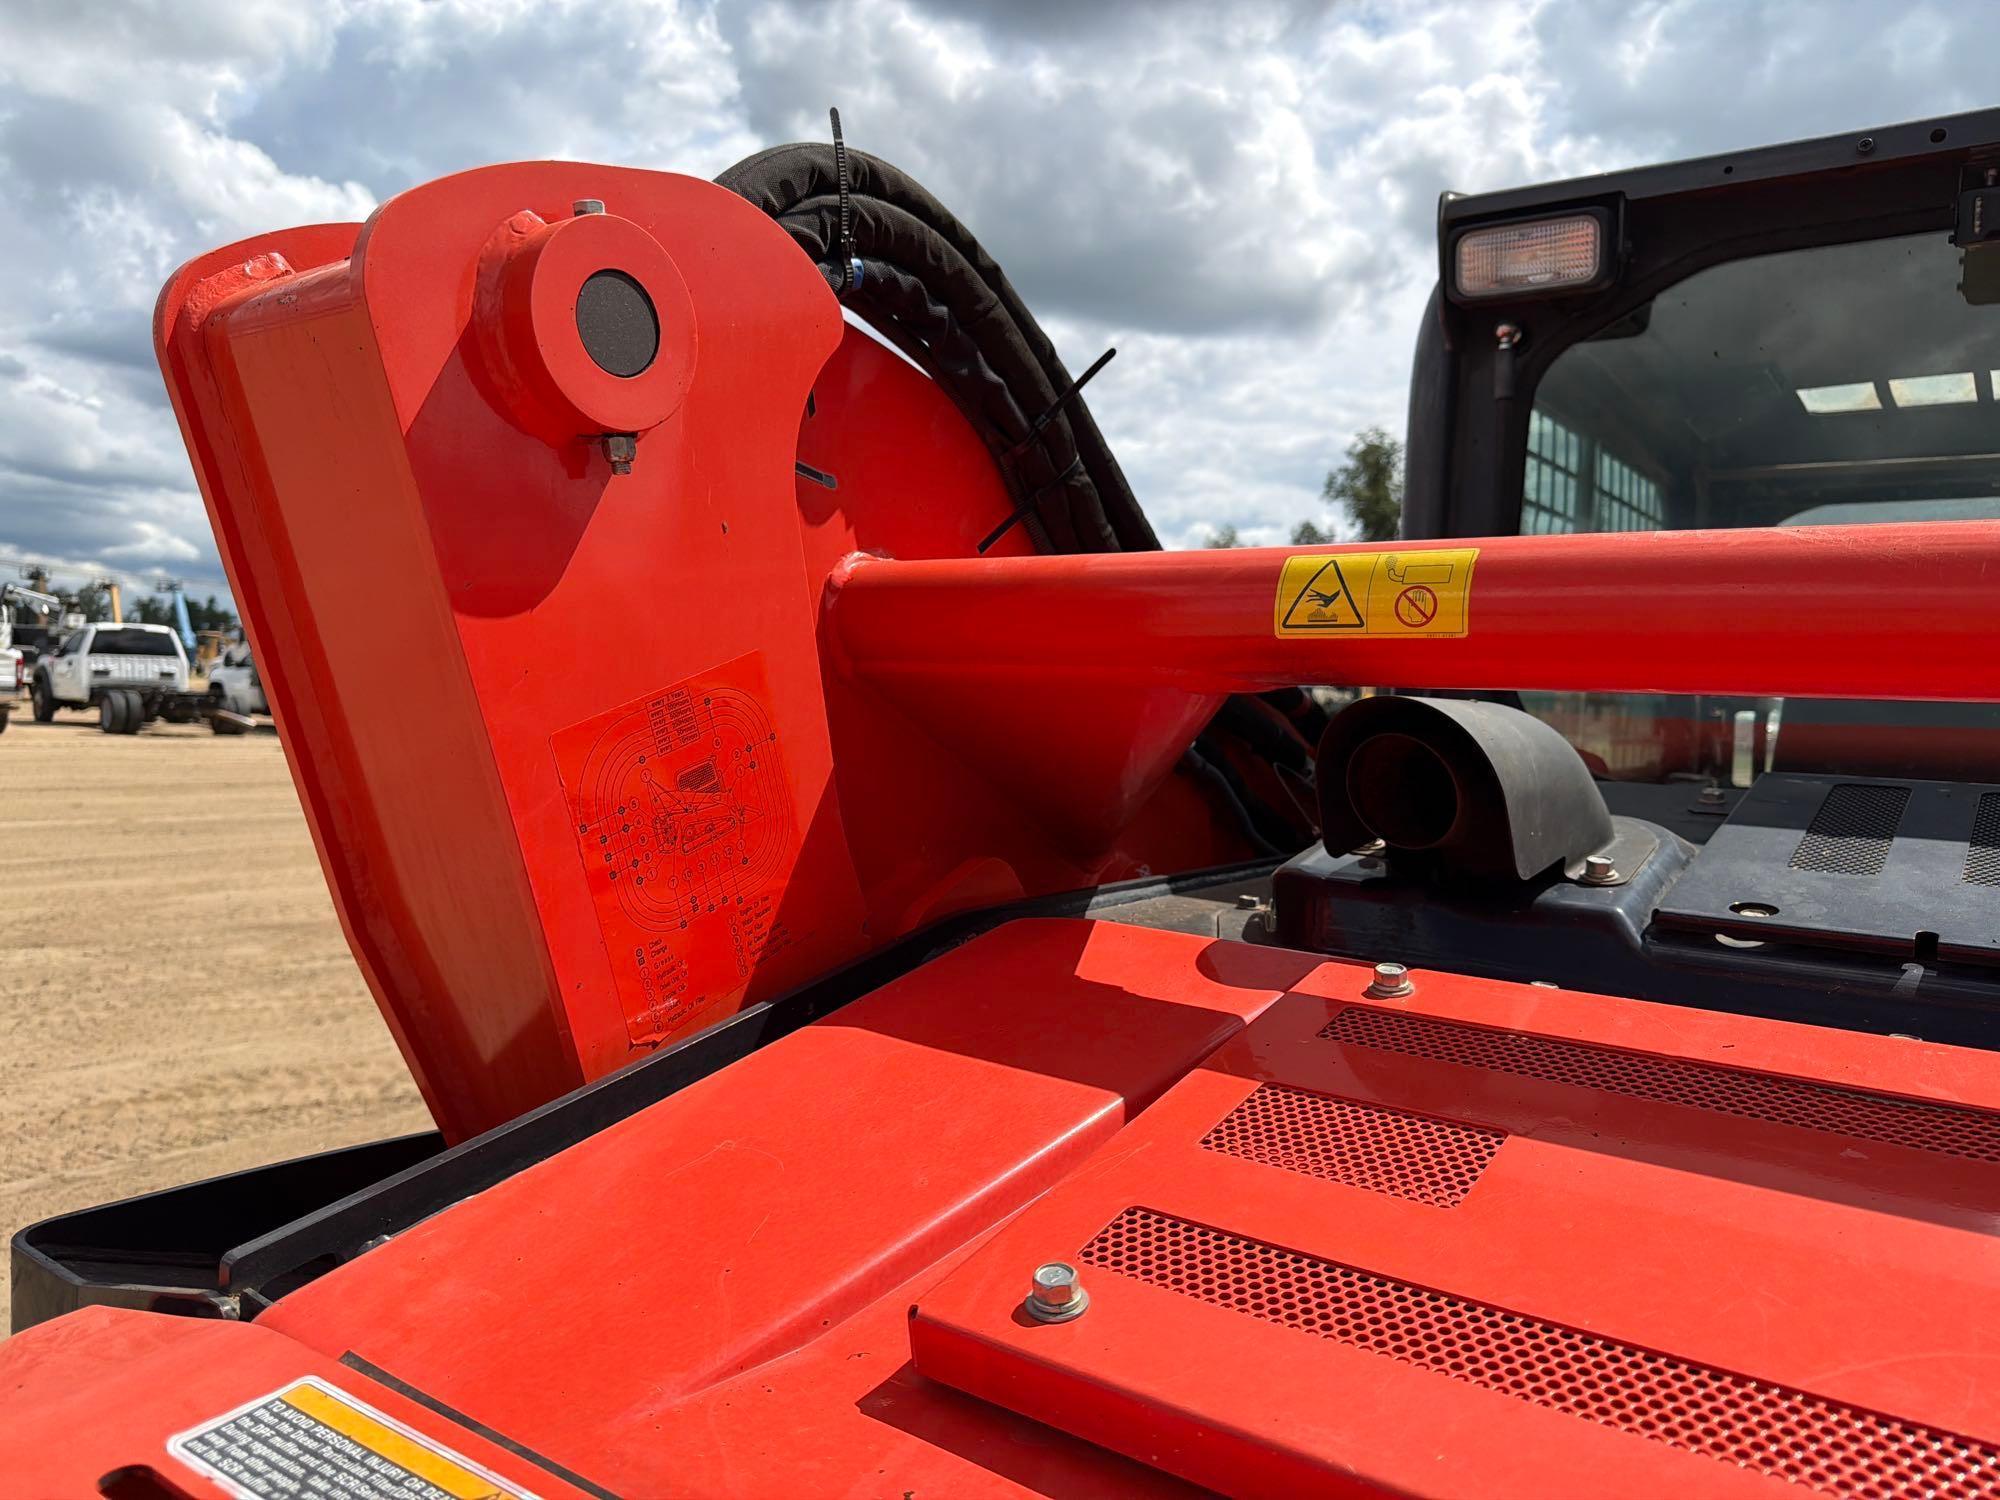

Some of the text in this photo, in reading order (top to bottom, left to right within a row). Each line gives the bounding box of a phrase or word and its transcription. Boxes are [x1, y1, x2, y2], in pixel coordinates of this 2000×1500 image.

[654, 954, 675, 969] Grease
[185, 1440, 273, 1494] and the SCR muffler
[220, 1422, 253, 1446] During
[307, 1475, 332, 1492] take
[224, 1443, 249, 1460] from
[244, 1456, 273, 1473] other
[236, 1415, 255, 1429] the
[250, 1423, 276, 1438] DPF
[269, 1435, 303, 1457] muffler
[298, 1454, 324, 1469] and
[316, 1463, 337, 1477] the
[252, 1407, 279, 1426] When
[275, 1421, 295, 1435] the
[290, 1429, 324, 1450] Diesel
[318, 1445, 370, 1478] Particulate
[266, 1400, 287, 1413] TO
[280, 1408, 316, 1429] AVOID
[309, 1425, 368, 1460] PERSONAL
[364, 1455, 410, 1481] INJURY
[403, 1477, 427, 1492] OR
